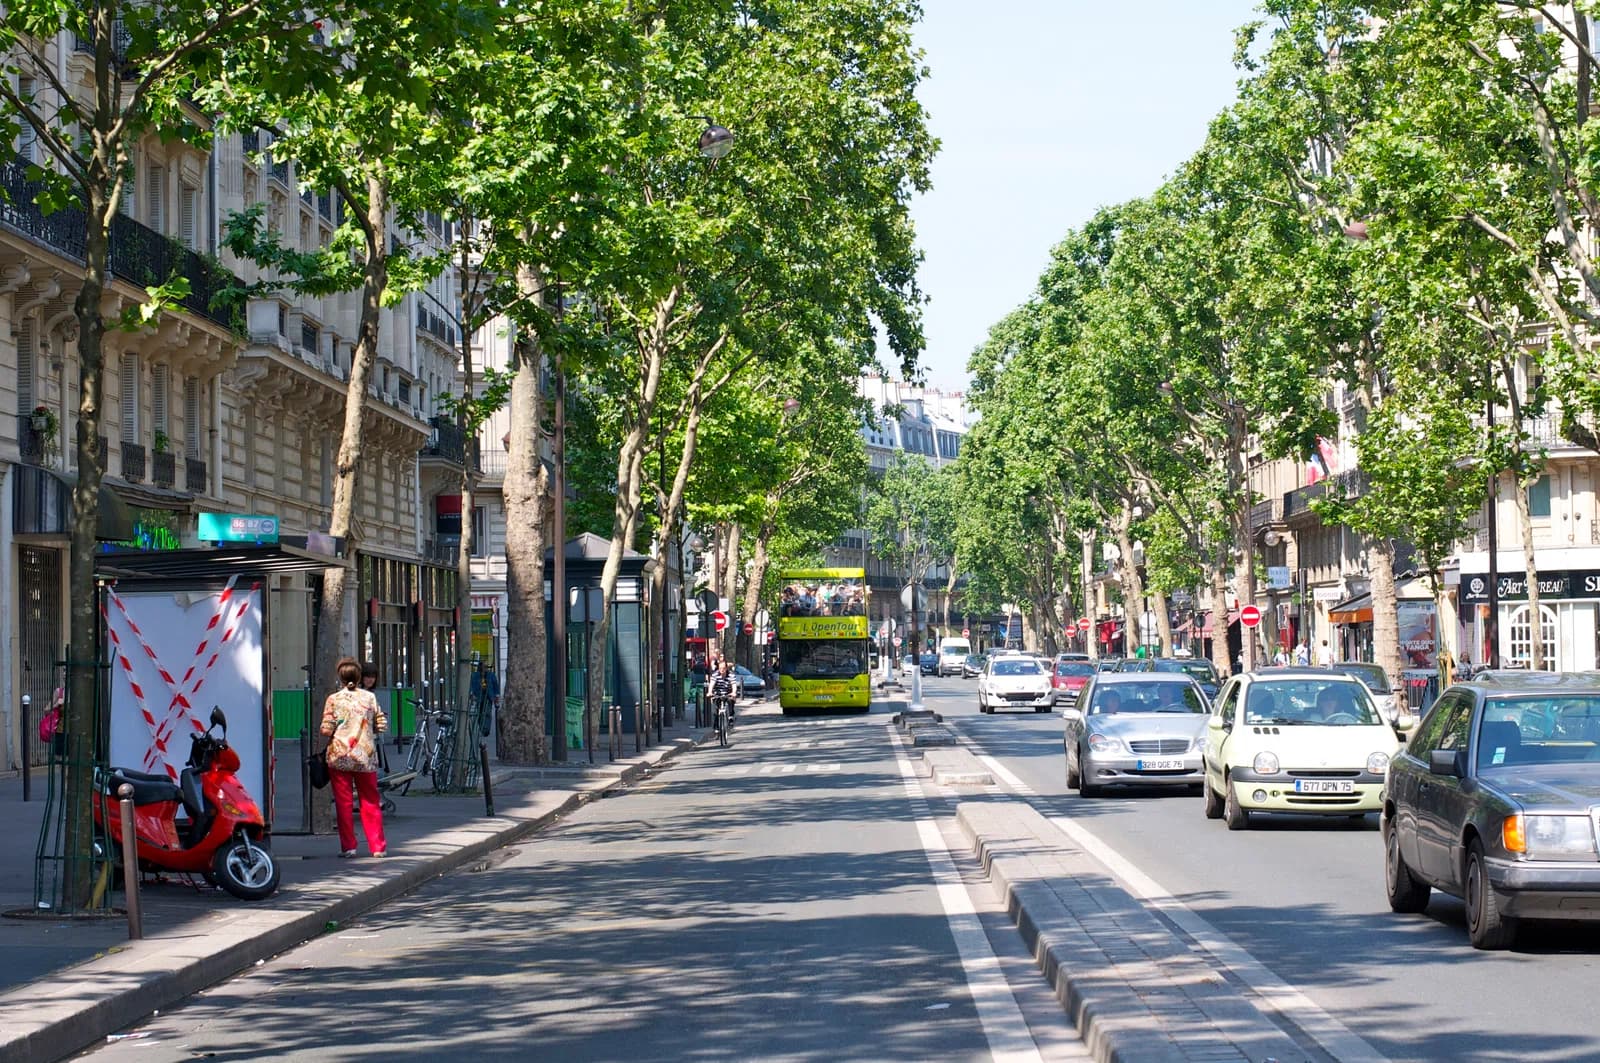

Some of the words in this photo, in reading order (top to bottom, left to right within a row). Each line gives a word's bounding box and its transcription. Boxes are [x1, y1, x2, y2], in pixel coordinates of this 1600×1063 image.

[1523, 577, 1565, 595] REAU
[1303, 781, 1320, 791] 677
[1340, 781, 1352, 791] 75
